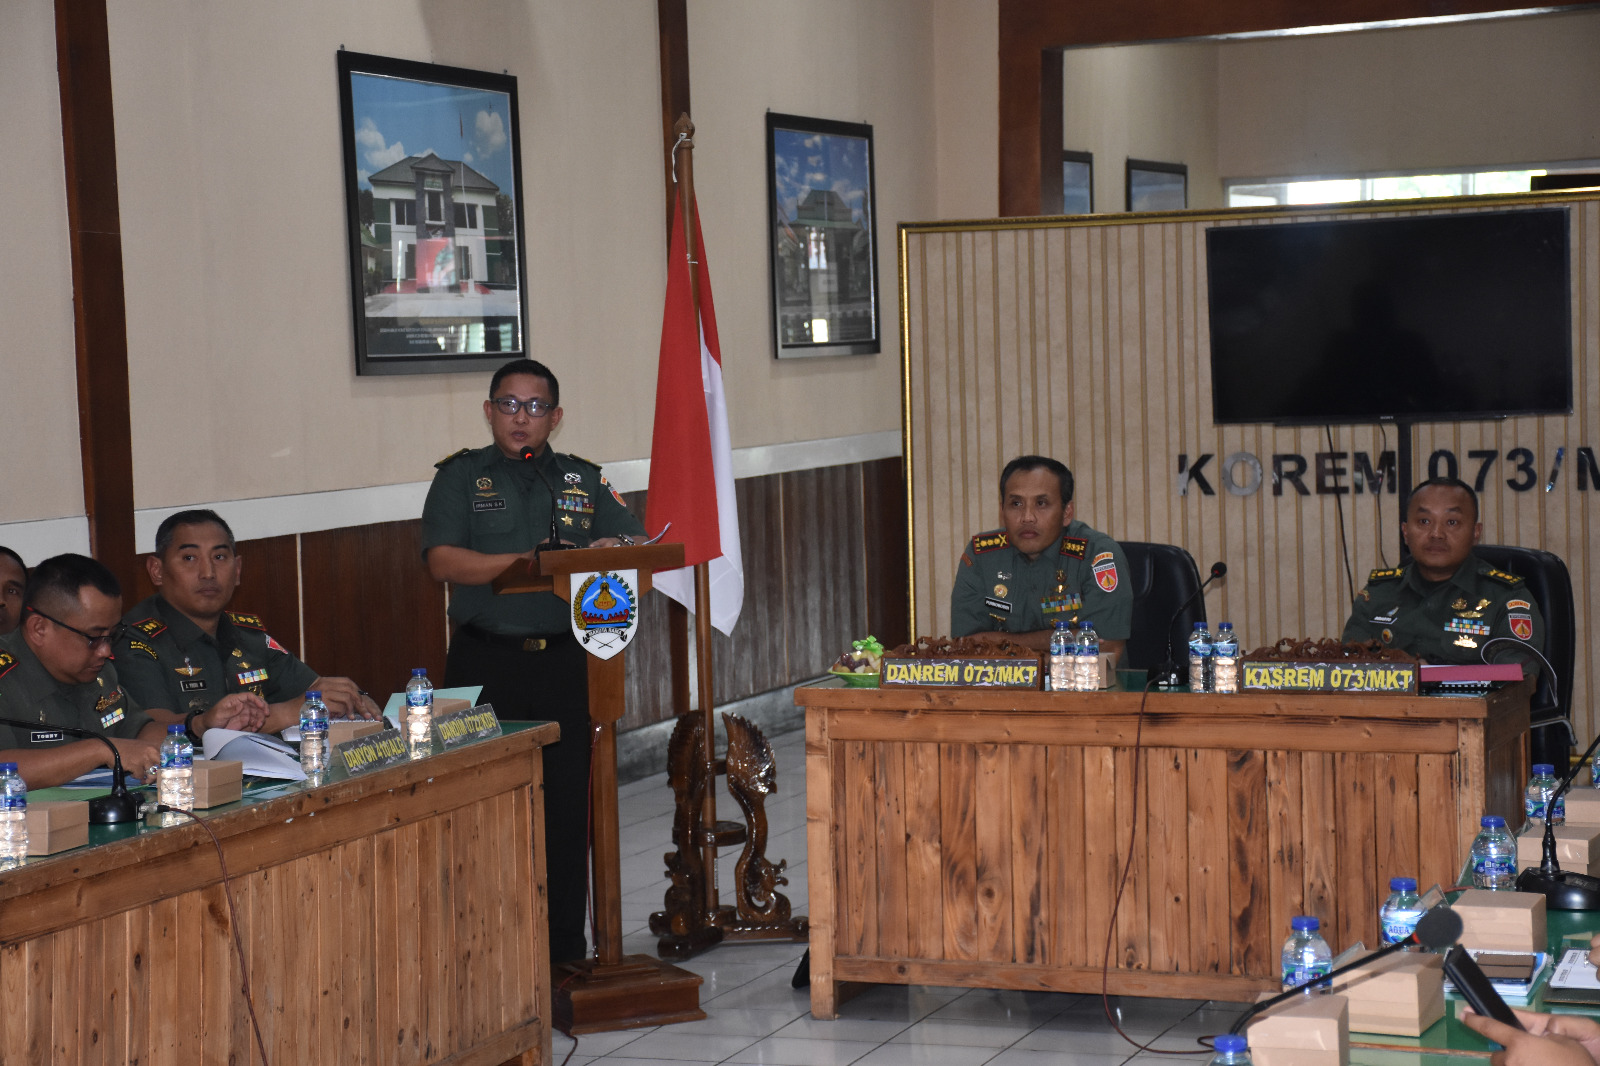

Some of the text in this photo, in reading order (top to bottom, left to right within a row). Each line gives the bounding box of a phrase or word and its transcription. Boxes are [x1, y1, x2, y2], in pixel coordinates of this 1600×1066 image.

[1178, 450, 1397, 497] KOREM
[886, 664, 1037, 683] DANREM 073/MKT
[1245, 667, 1413, 689] KASREM 073/MKT
[343, 744, 378, 768] DANYON
[1388, 925, 1411, 934] AQUA
